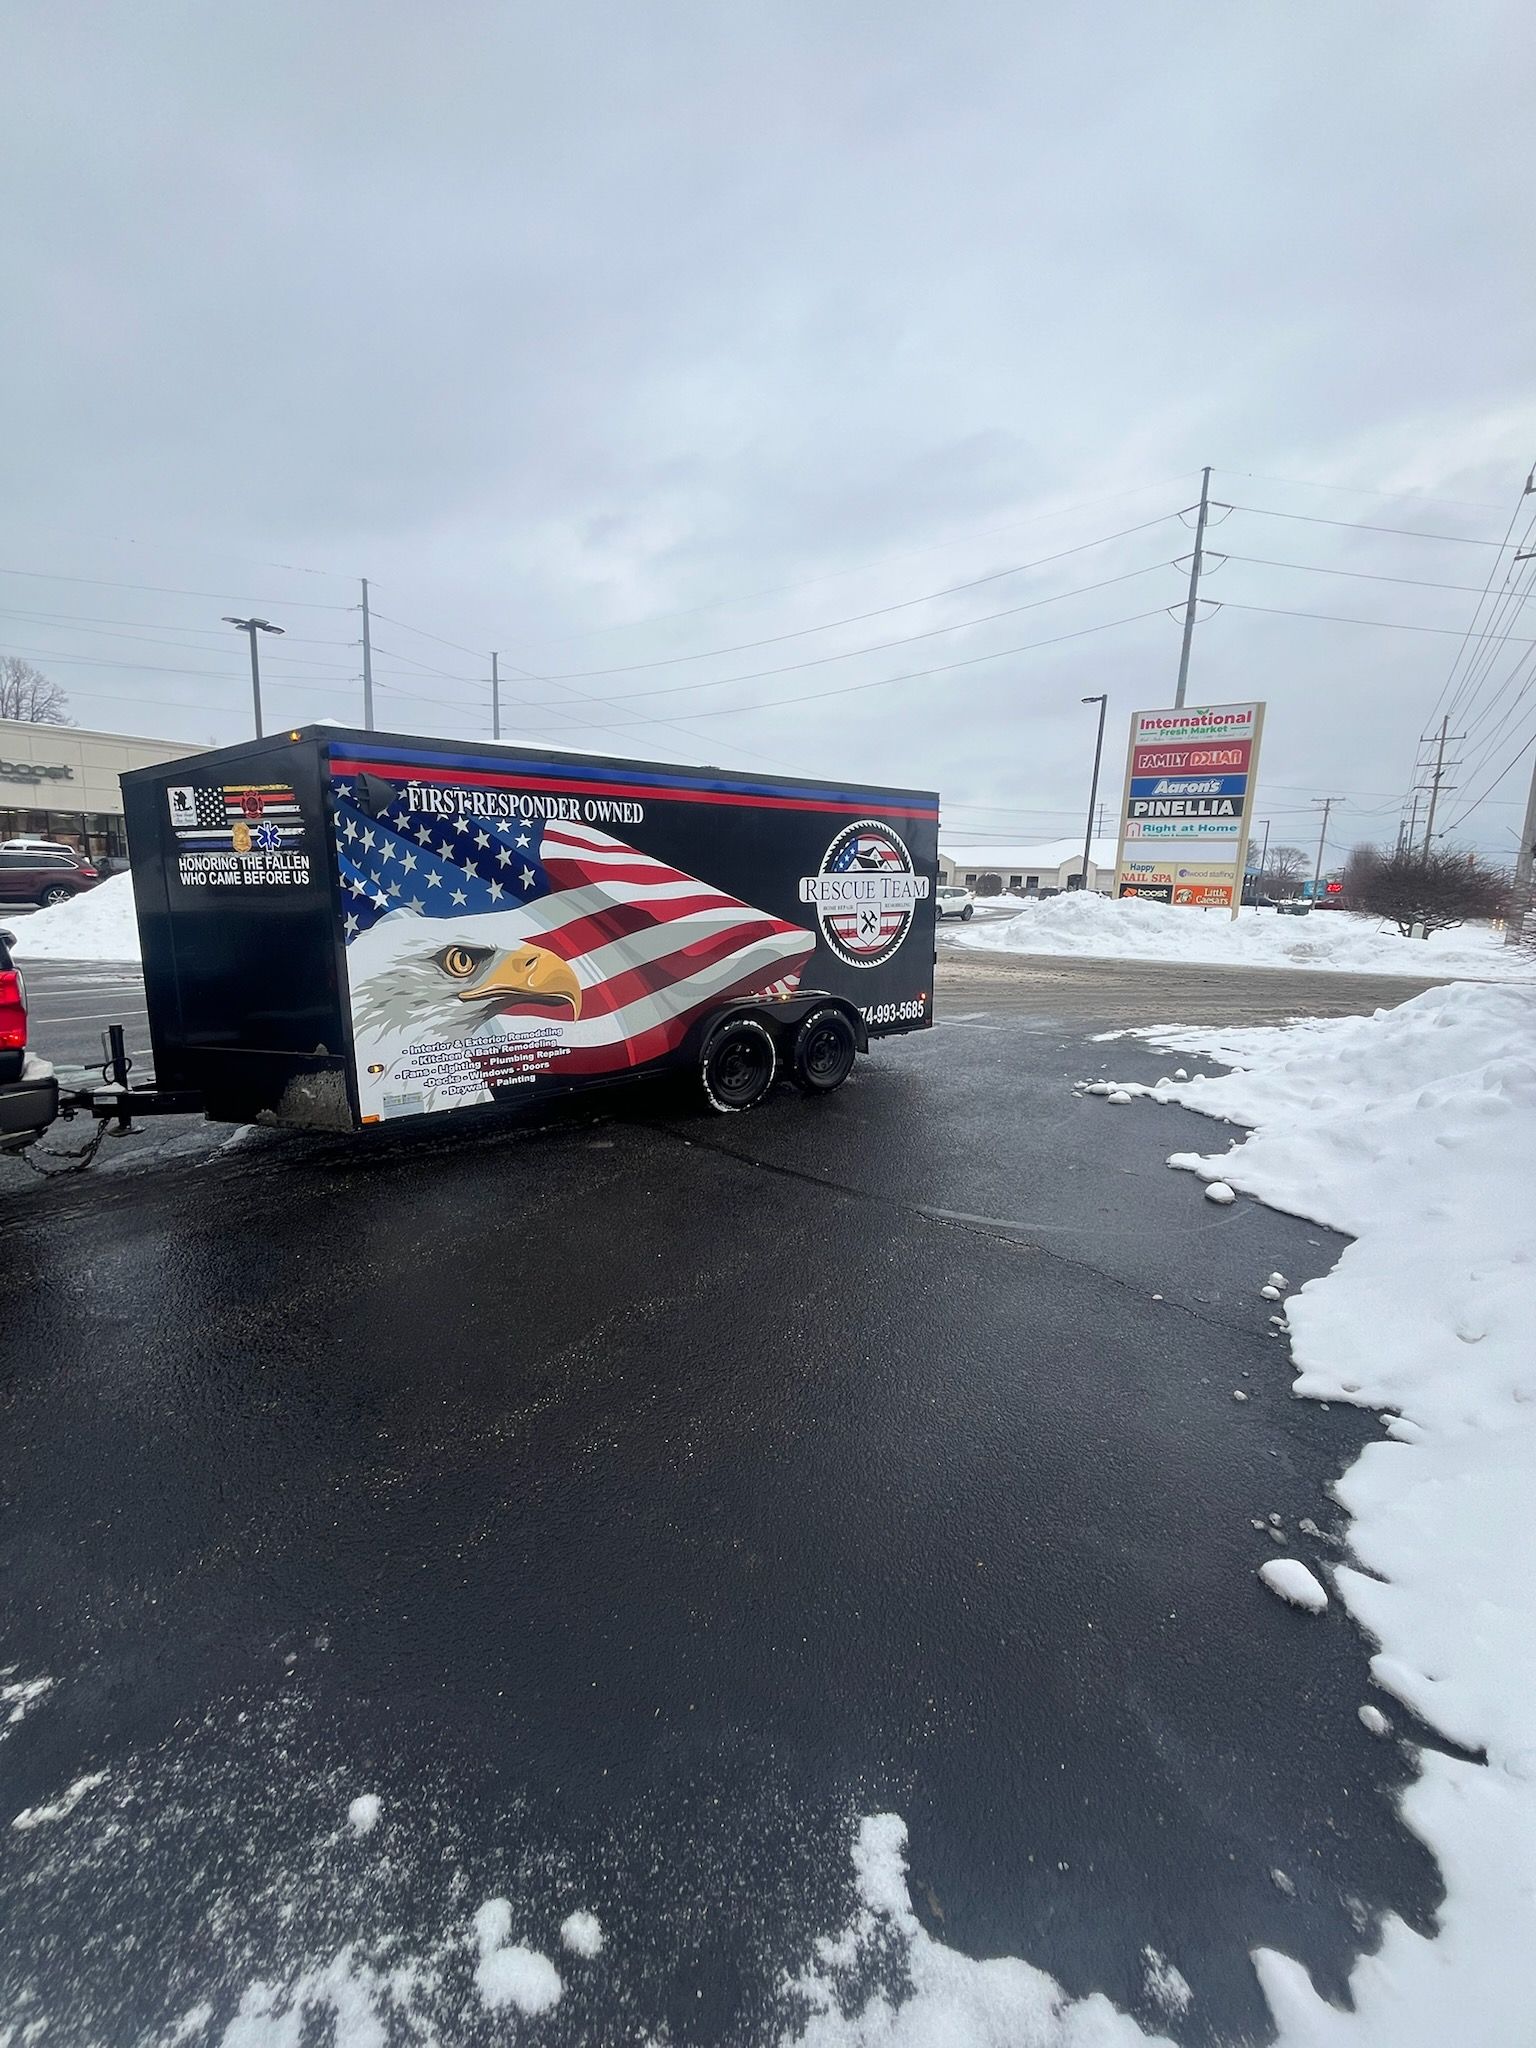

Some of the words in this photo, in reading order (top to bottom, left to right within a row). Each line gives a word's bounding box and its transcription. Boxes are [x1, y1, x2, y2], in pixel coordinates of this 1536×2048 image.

[1140, 711, 1252, 729] International
[1160, 728, 1188, 736] Fresh
[1191, 726, 1228, 734] Market
[1139, 753, 1189, 768] FAMILY
[1152, 779, 1222, 795] Aaron's
[407, 787, 467, 814] FIRST
[471, 791, 581, 820] RESPONDER
[584, 799, 643, 823] OWNED
[1133, 800, 1234, 816] PINELLIA
[1143, 824, 1176, 833] Right
[1181, 824, 1194, 832] at
[1198, 824, 1238, 832] Home
[179, 857, 238, 871] HONORING
[240, 857, 264, 870] THE
[265, 856, 310, 870] FALLEN
[1130, 863, 1155, 873] Happy
[180, 872, 207, 885] WHO
[209, 872, 242, 885] CAME
[244, 871, 292, 884] BEFORE
[292, 871, 310, 884] US
[1121, 873, 1148, 882] NAIL
[1151, 874, 1172, 883] SPA
[805, 879, 876, 900] RESCUE
[880, 878, 927, 899] TEAM
[1138, 889, 1168, 897] boost
[1204, 888, 1228, 897] Little
[1195, 896, 1229, 905] Caesars
[858, 1000, 924, 1024] 74-993-5685
[410, 1042, 451, 1055] Interior
[453, 1040, 463, 1048] &
[464, 1035, 506, 1047] Exterior
[507, 1028, 563, 1041] Remodeling
[419, 1053, 462, 1065] Kitchen
[464, 1049, 473, 1059] &
[475, 1046, 499, 1057] Bath
[501, 1039, 557, 1053] Remodeling
[402, 1069, 430, 1079] Fans
[438, 1061, 481, 1074] Lighting
[489, 1052, 534, 1066] Plumbing
[536, 1047, 571, 1060] Repairs
[469, 1067, 514, 1080] Windows
[522, 1061, 550, 1072] Doors
[449, 1081, 489, 1095] Drywall
[496, 1074, 536, 1087] Painting
